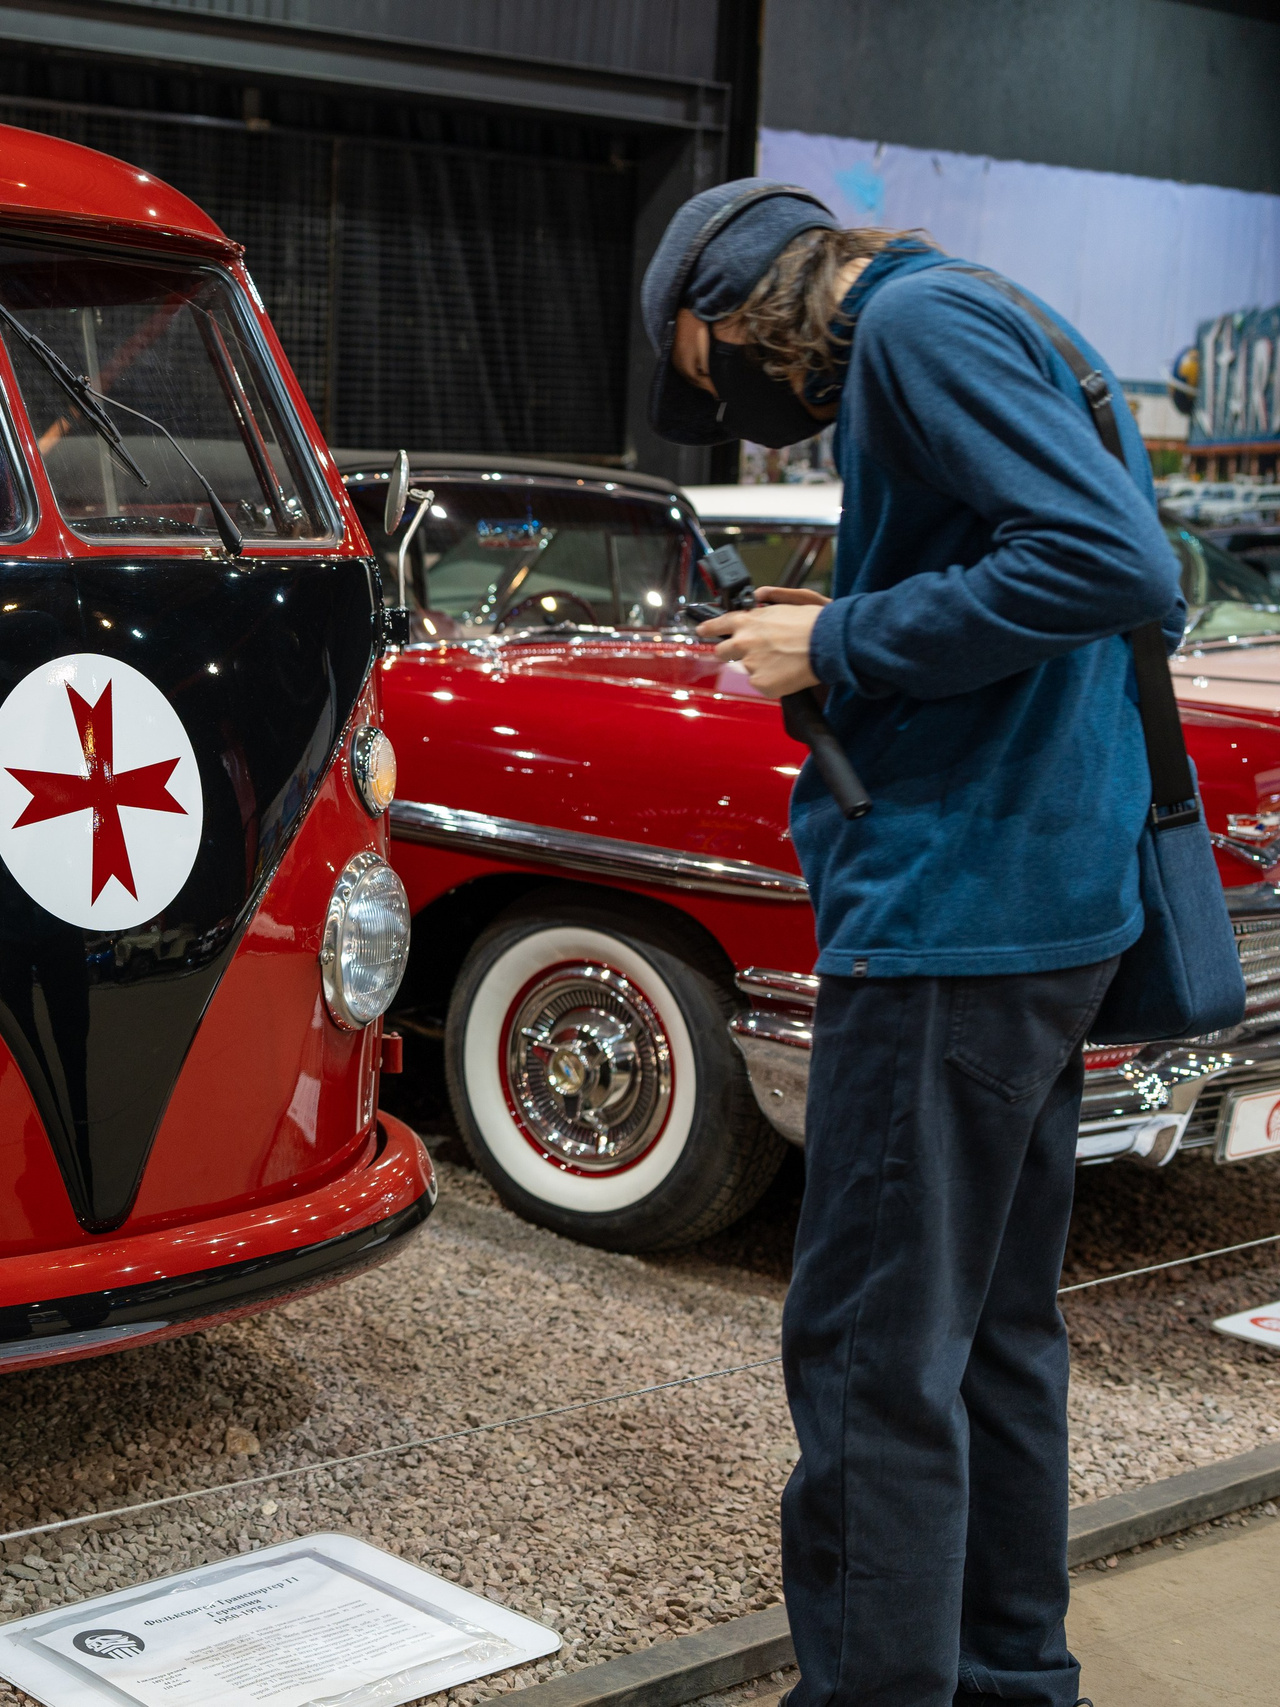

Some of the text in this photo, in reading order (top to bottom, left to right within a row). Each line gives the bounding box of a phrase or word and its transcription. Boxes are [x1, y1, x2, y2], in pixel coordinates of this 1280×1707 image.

[216, 1582, 285, 1605] Транспортер
[206, 1598, 261, 1618] Германия
[213, 1605, 267, 1625] 1950-1975
